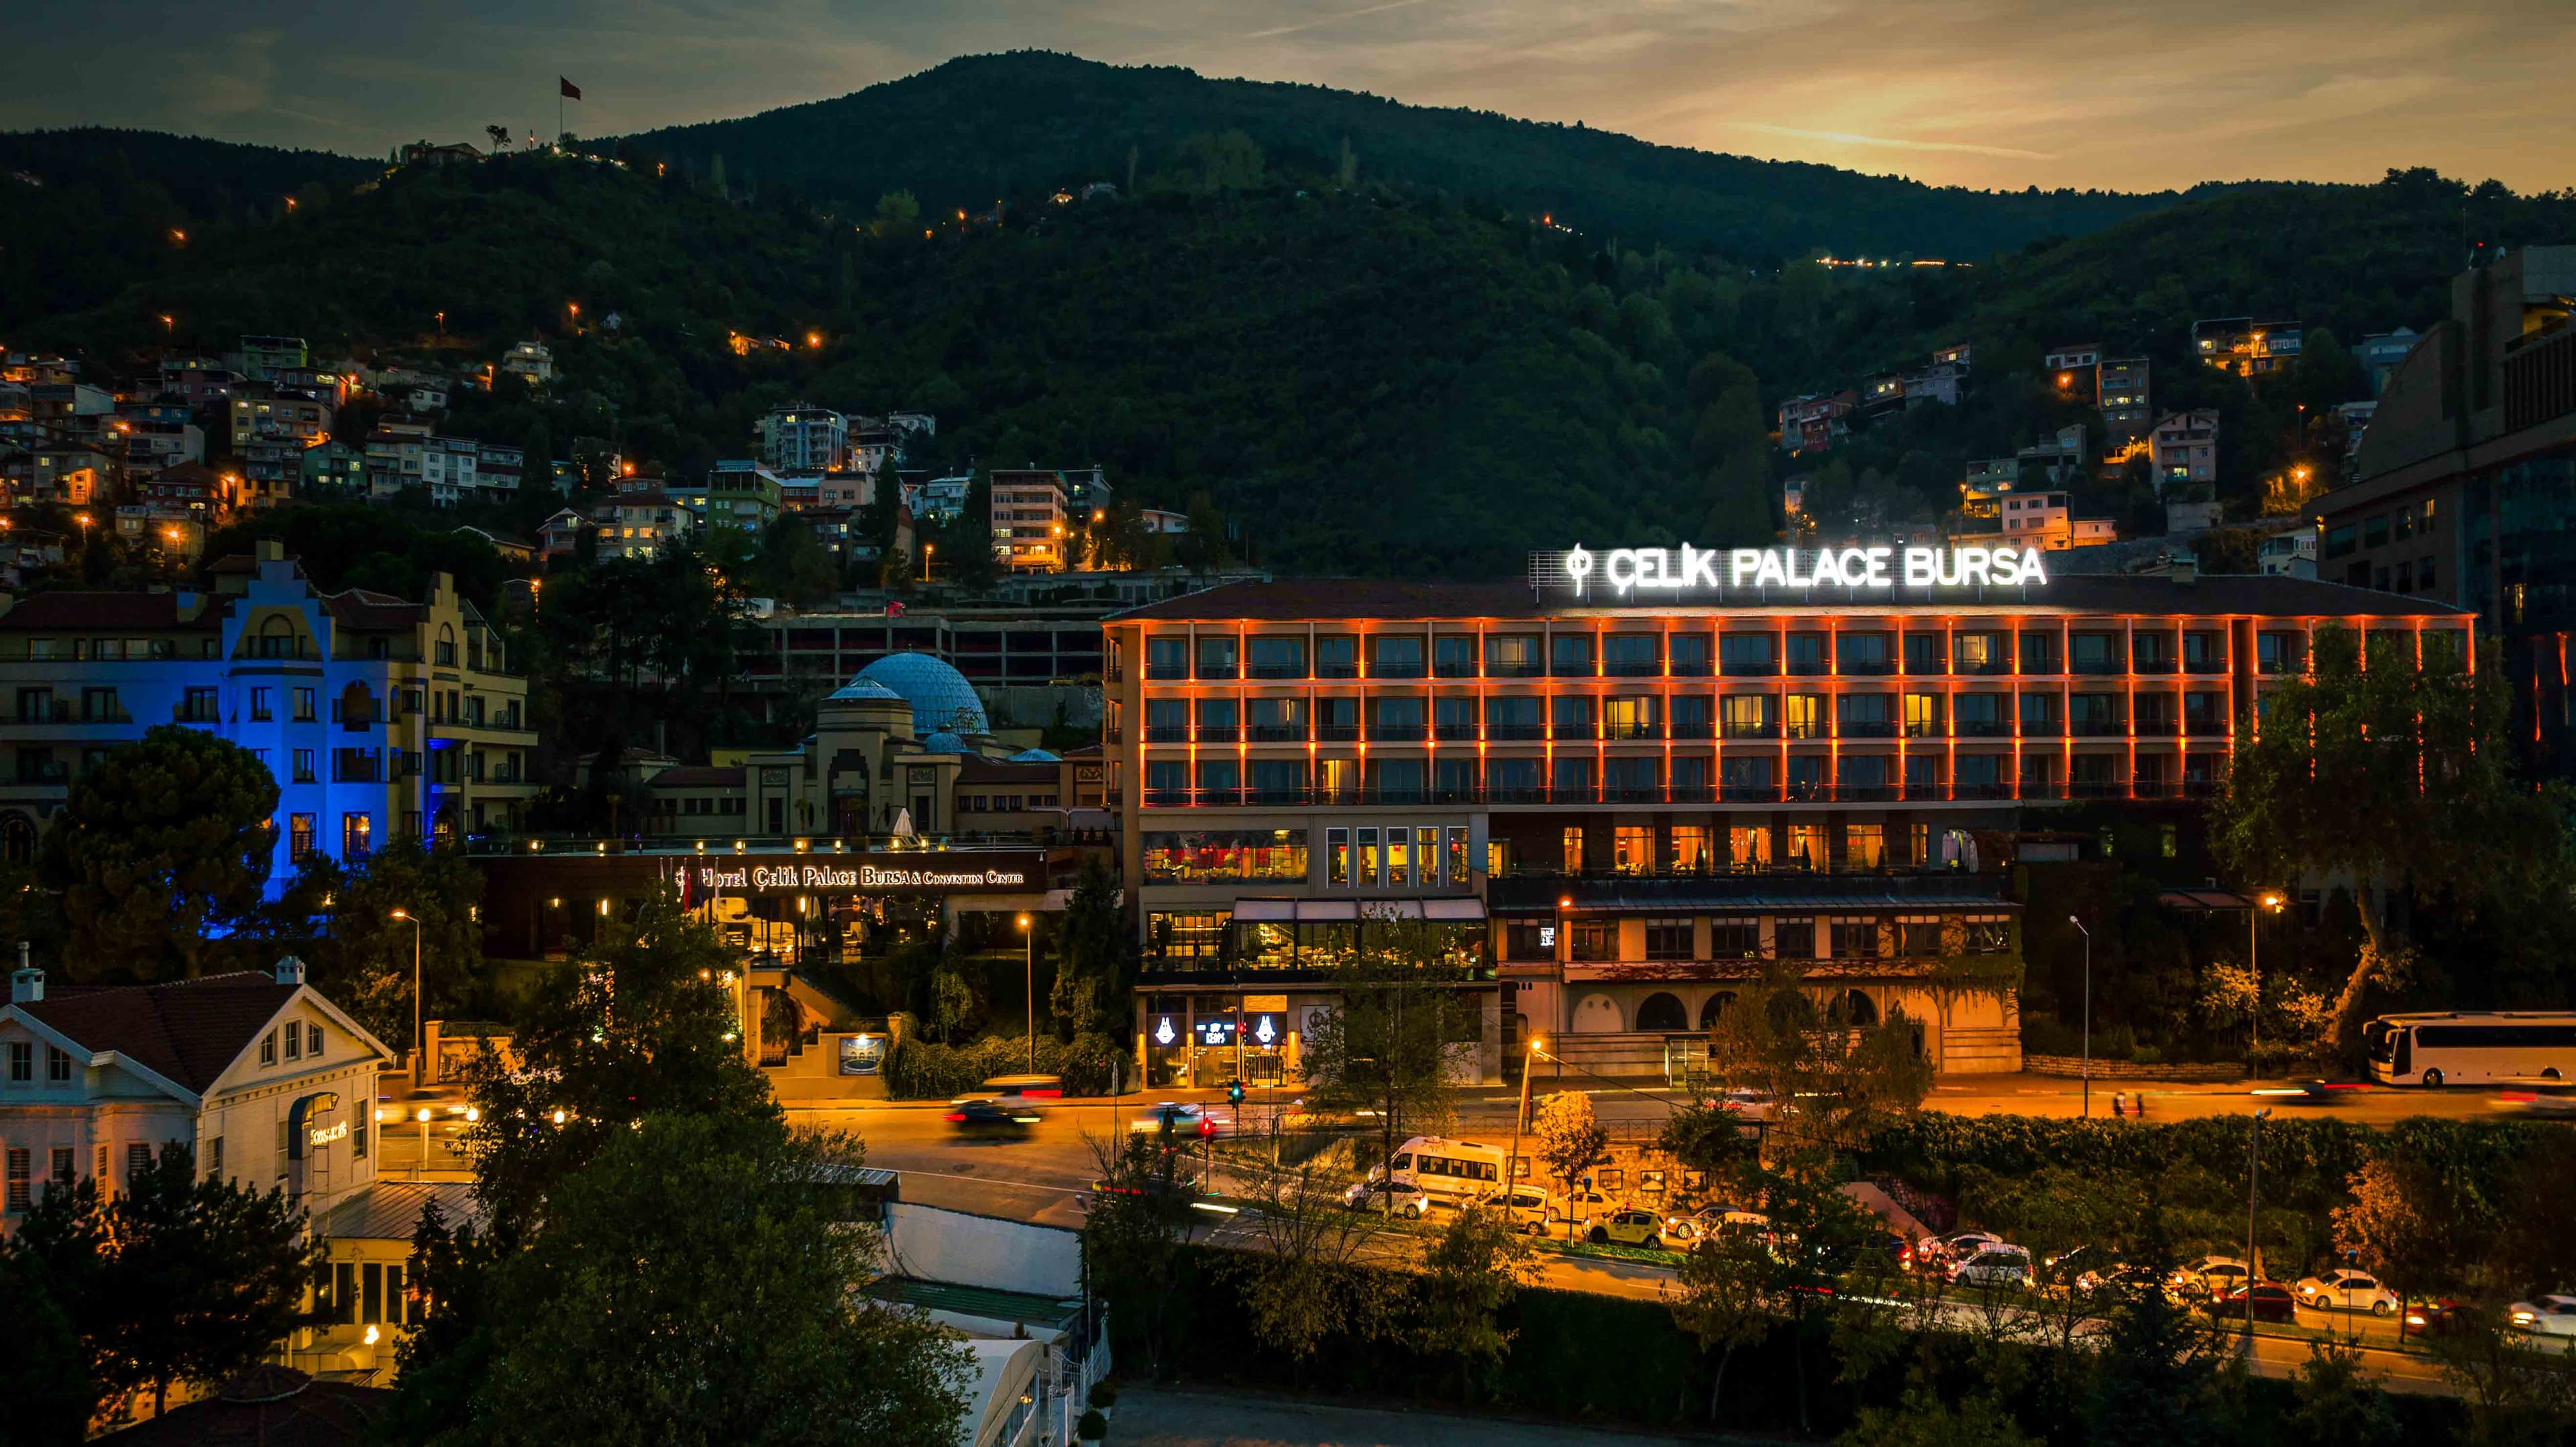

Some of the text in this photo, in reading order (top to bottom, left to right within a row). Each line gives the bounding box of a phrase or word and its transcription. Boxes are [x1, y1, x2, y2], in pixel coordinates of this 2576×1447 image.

[1731, 547, 1892, 587] PALACE
[1905, 547, 2048, 586] BURSA
[912, 872, 922, 885] &
